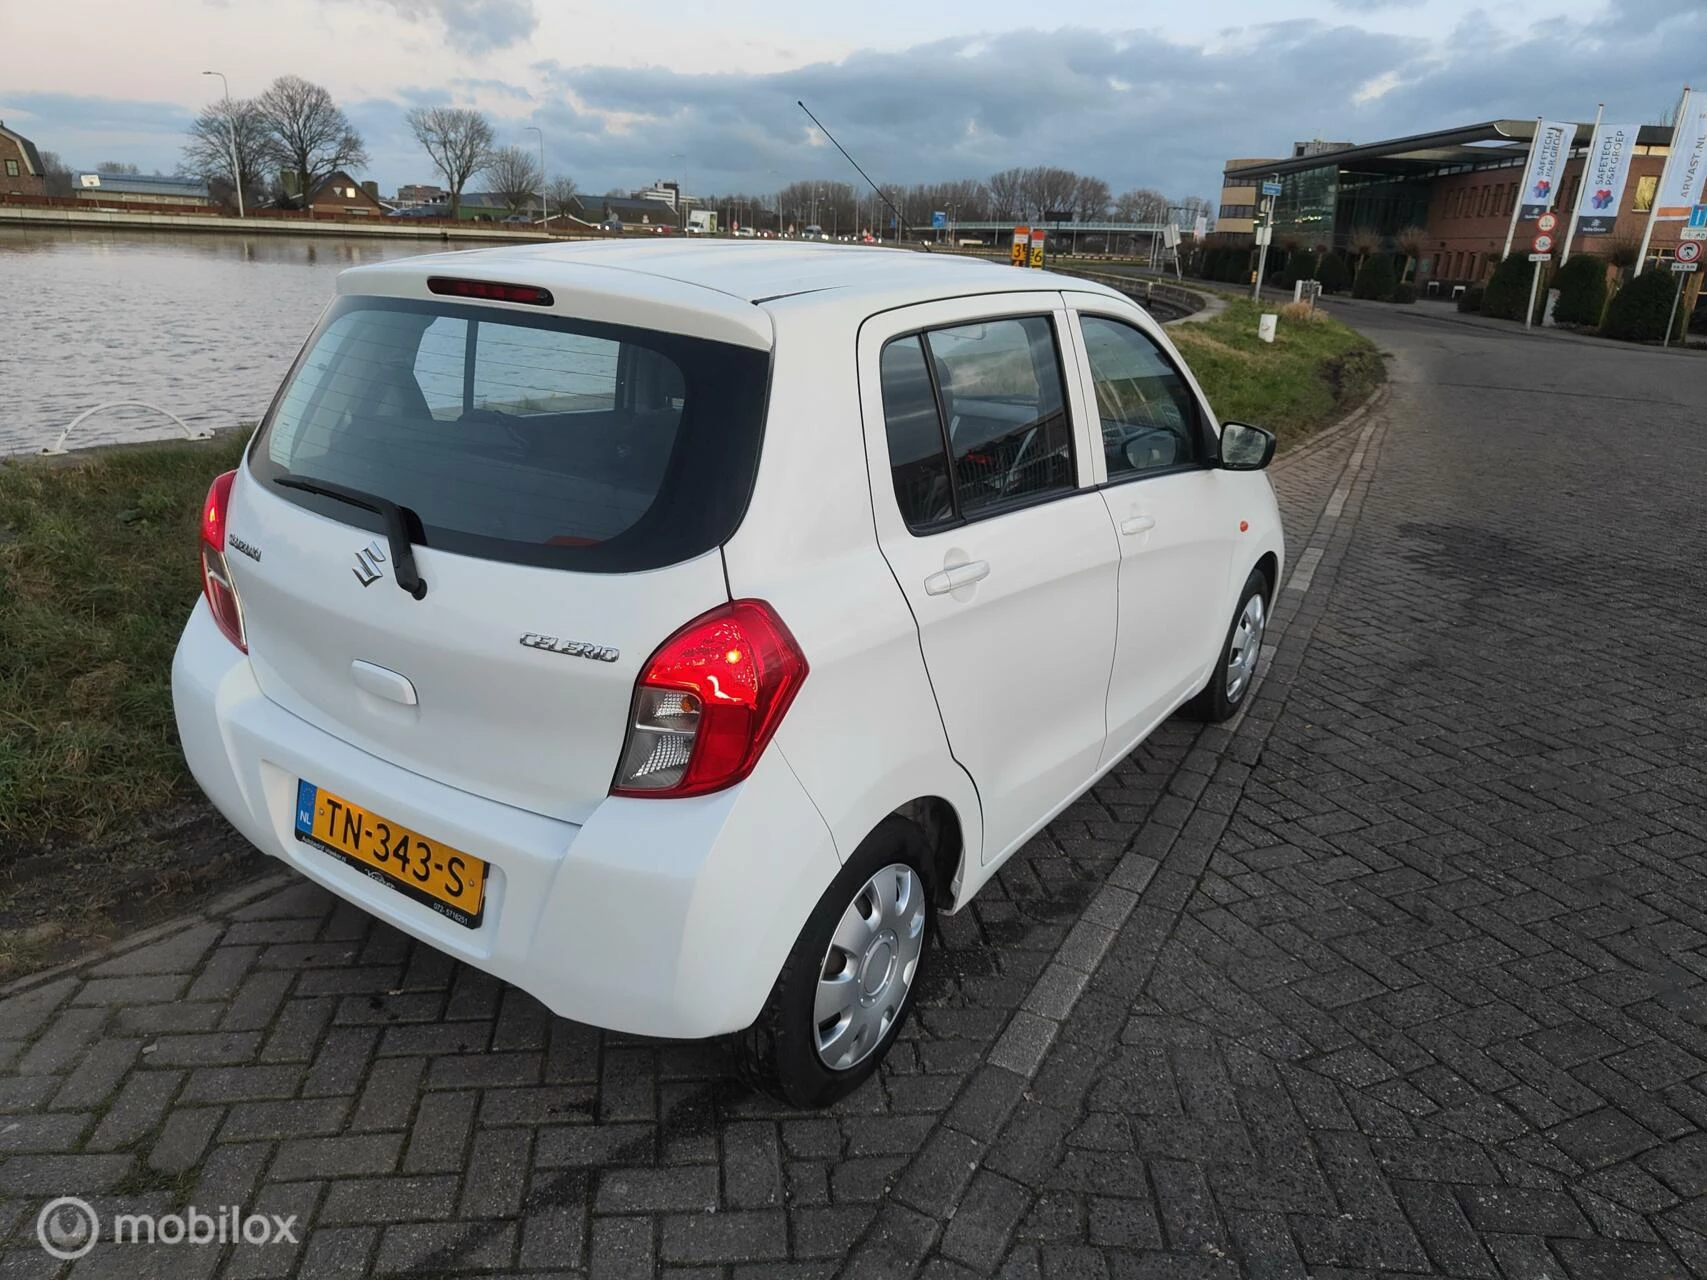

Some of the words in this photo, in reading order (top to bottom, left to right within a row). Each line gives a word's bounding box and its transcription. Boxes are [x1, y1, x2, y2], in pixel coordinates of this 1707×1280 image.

[1595, 136, 1614, 185] SAFETECH
[1612, 130, 1625, 165] GROEP
[228, 533, 262, 562] SUZUKI
[519, 632, 620, 663] CELERIO
[300, 811, 312, 825] NL
[327, 798, 465, 898] TN-343-S
